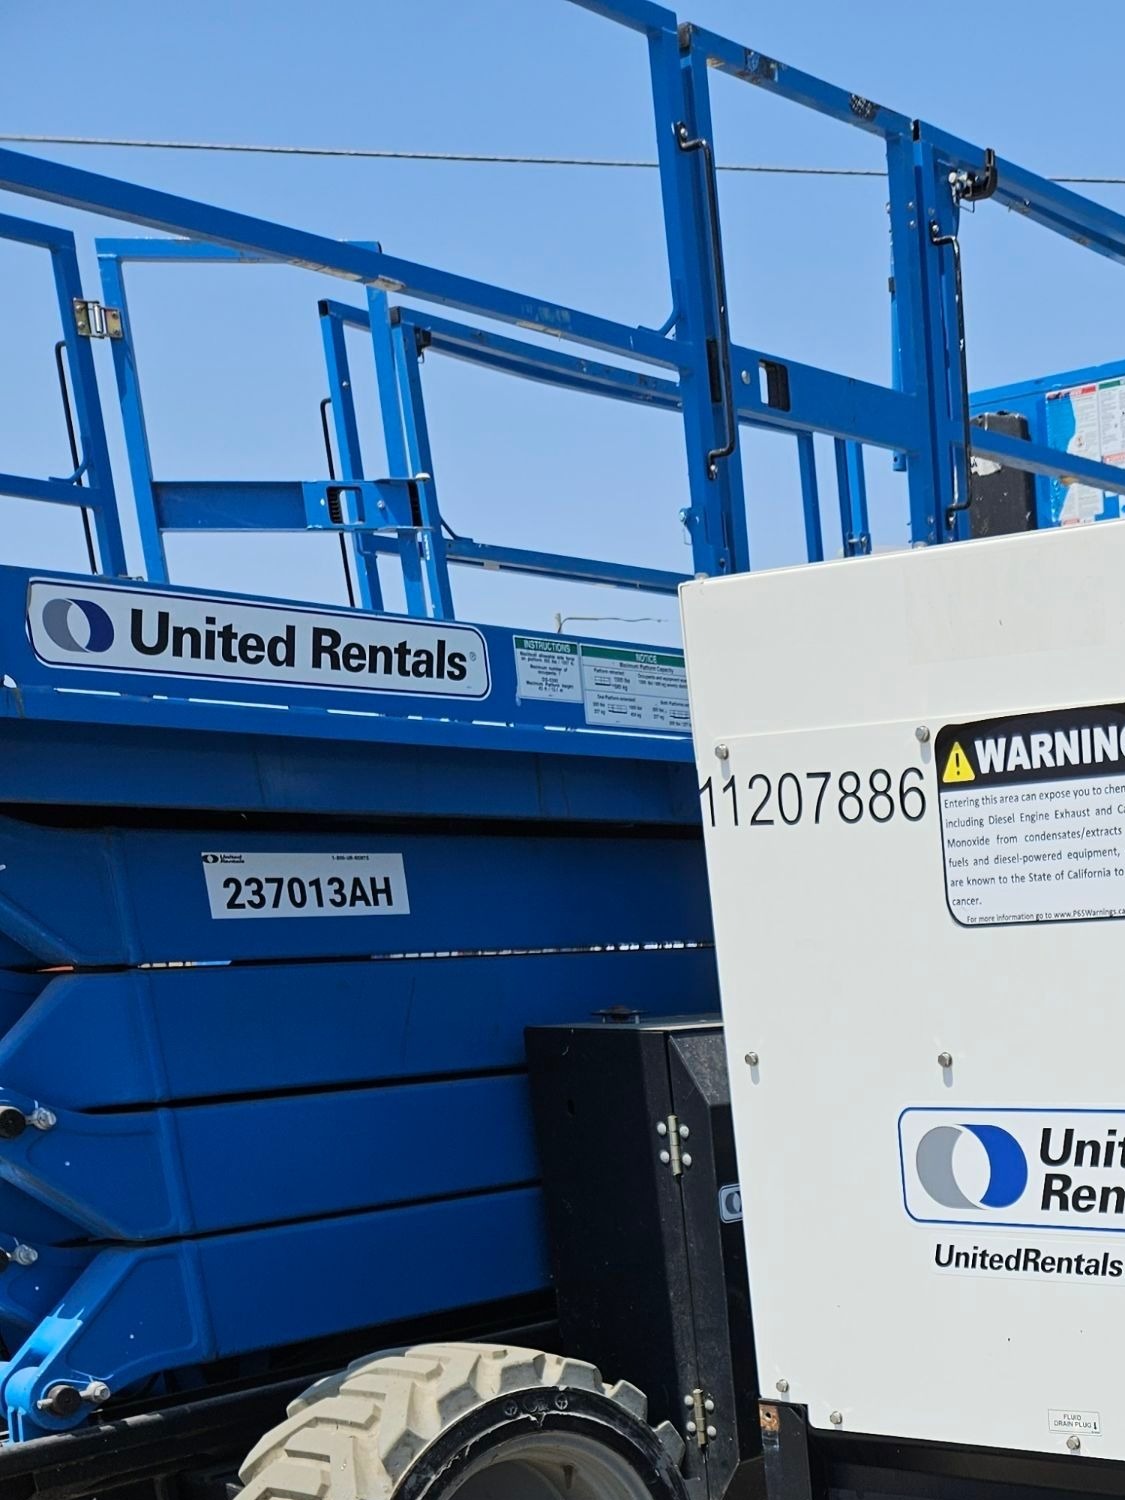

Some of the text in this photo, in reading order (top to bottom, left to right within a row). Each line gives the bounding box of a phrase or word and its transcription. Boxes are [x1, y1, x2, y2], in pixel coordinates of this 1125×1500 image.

[130, 607, 467, 681] United Rentals
[524, 640, 570, 653] INSTRUCTIONS
[700, 767, 926, 827] 11207886
[945, 796, 979, 809] Entering
[982, 794, 997, 806] this
[1000, 794, 1019, 804] area
[1021, 792, 1036, 801] can
[1039, 789, 1070, 801] expose
[1073, 787, 1090, 798] you
[1092, 786, 1102, 795] to
[946, 815, 984, 828] including
[988, 813, 1015, 825] Diesel
[1020, 811, 1049, 824] Engine
[1055, 808, 1090, 820] Exhaust
[1096, 806, 1112, 816] and
[948, 835, 990, 848] Monoxide
[997, 833, 1017, 845] from
[1024, 825, 1122, 843] condensates/extracts
[949, 856, 968, 867] fuels
[973, 855, 989, 866] and
[994, 850, 1062, 865] diesel-powered
[1067, 847, 1120, 860] equipment,
[951, 878, 963, 887] are
[967, 874, 995, 886] known
[998, 875, 1008, 884] to
[1011, 873, 1025, 883] the
[1029, 872, 1051, 882] State
[1055, 870, 1064, 880] of
[1067, 867, 1111, 880] California
[1115, 867, 1124, 877] to
[223, 877, 393, 909] 237013AH
[952, 897, 982, 906] cancer.
[967, 915, 976, 923] For
[979, 915, 994, 923] more
[997, 912, 1034, 922] information
[1036, 912, 1043, 920] go
